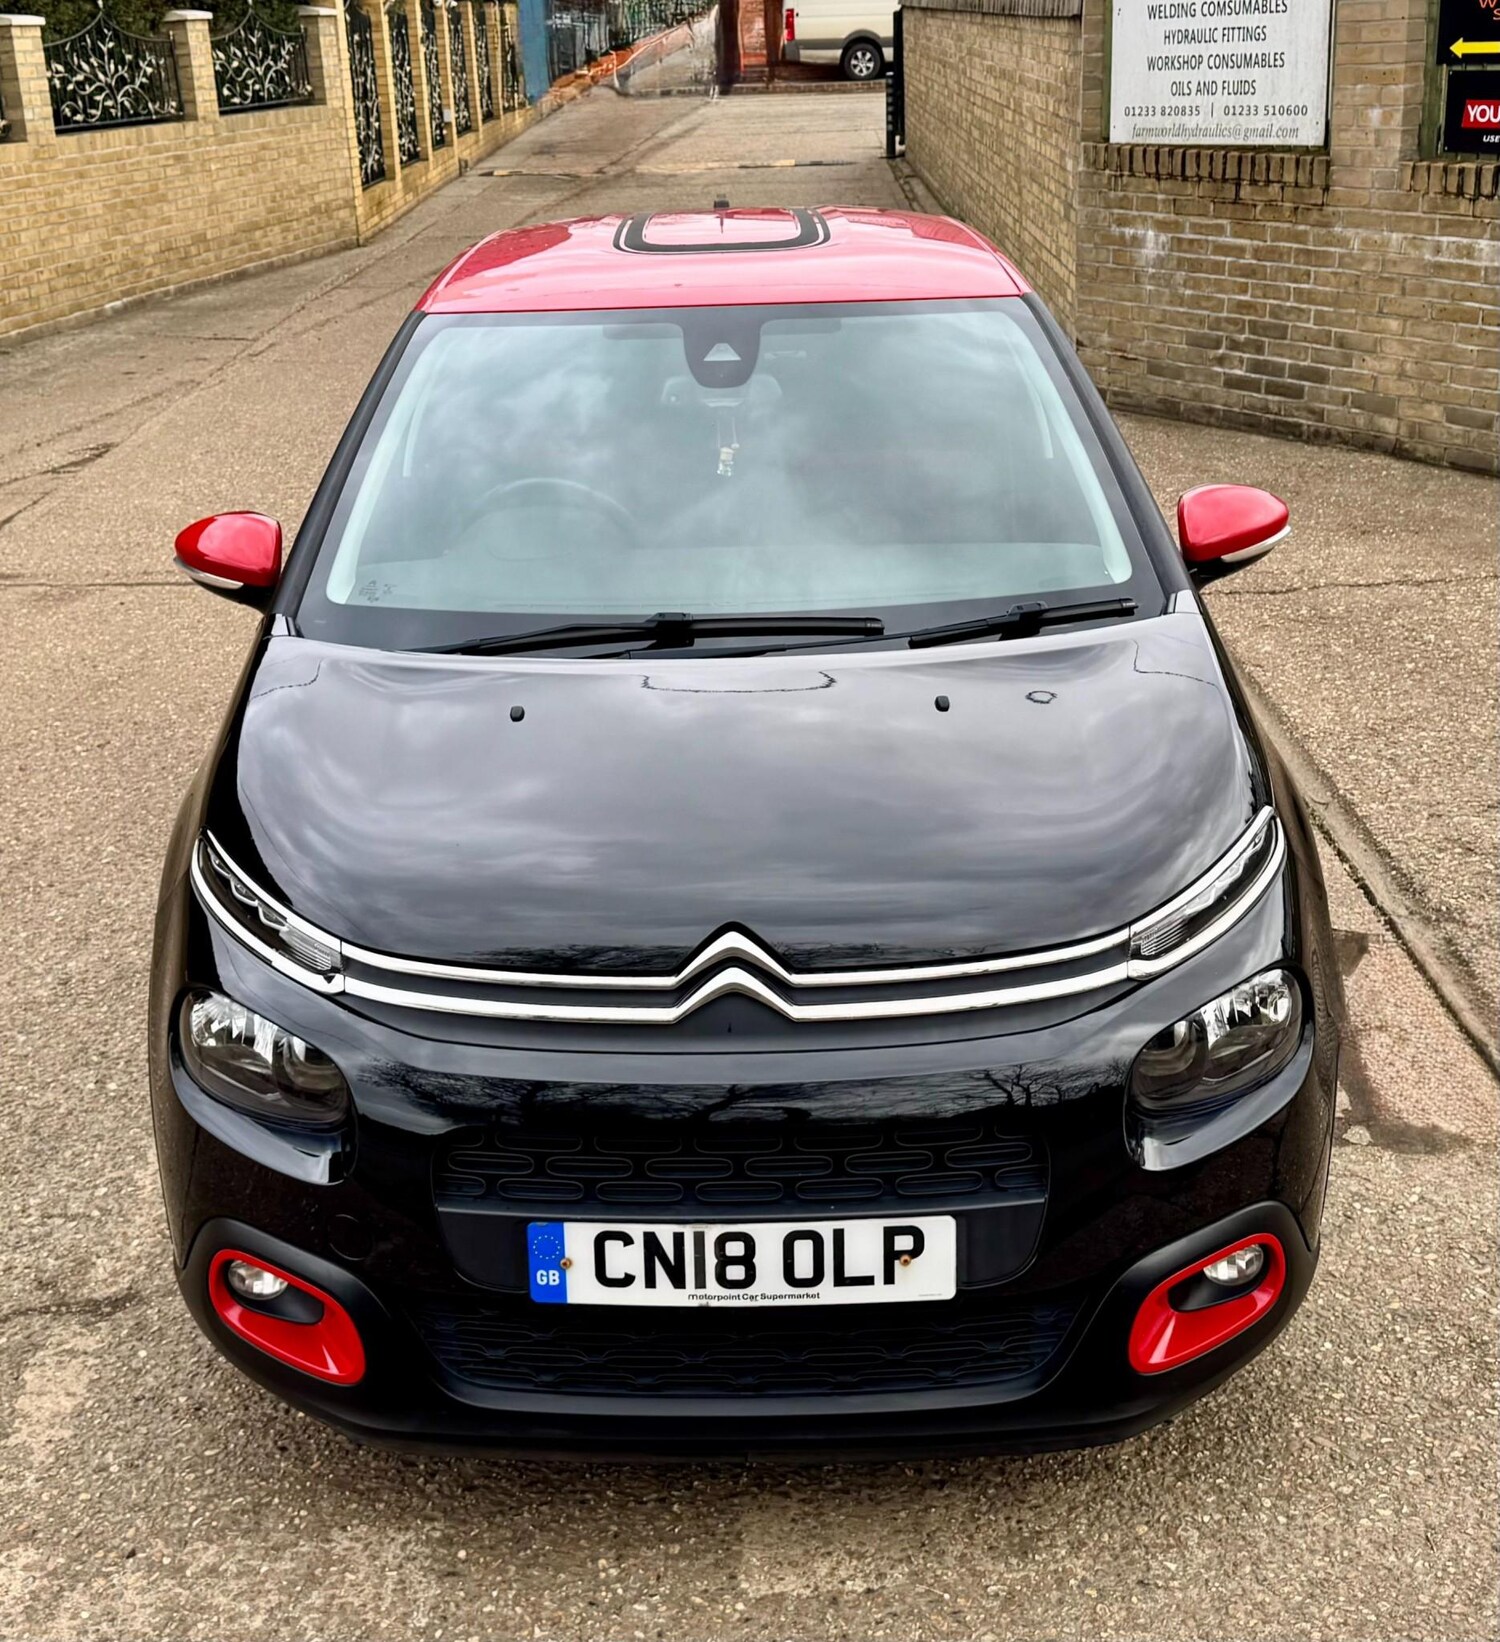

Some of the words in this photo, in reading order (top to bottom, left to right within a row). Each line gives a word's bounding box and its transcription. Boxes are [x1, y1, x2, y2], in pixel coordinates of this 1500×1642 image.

[1147, 2, 1196, 20] WELDING
[1200, 0, 1288, 17] COMSUMABLES
[1164, 27, 1218, 45] HYDRAULIC
[1222, 25, 1267, 42] FITTINGS
[1147, 54, 1203, 71] WORKSHOP
[1207, 52, 1285, 70] CONSUMABLES
[1170, 81, 1192, 96] OILS
[1195, 80, 1218, 96] AND
[1222, 79, 1257, 95] FLUIDS
[1124, 106, 1157, 117] 01233
[1160, 105, 1200, 117] 820835
[1223, 105, 1259, 116] 01233
[1263, 104, 1308, 116] 510600
[1131, 122, 1299, 140] farmworldhydraulics@gmail.com
[593, 1230, 756, 1289] CN18
[782, 1225, 925, 1288] OLP
[536, 1269, 560, 1286] GB
[760, 1292, 820, 1301] Supermarket
